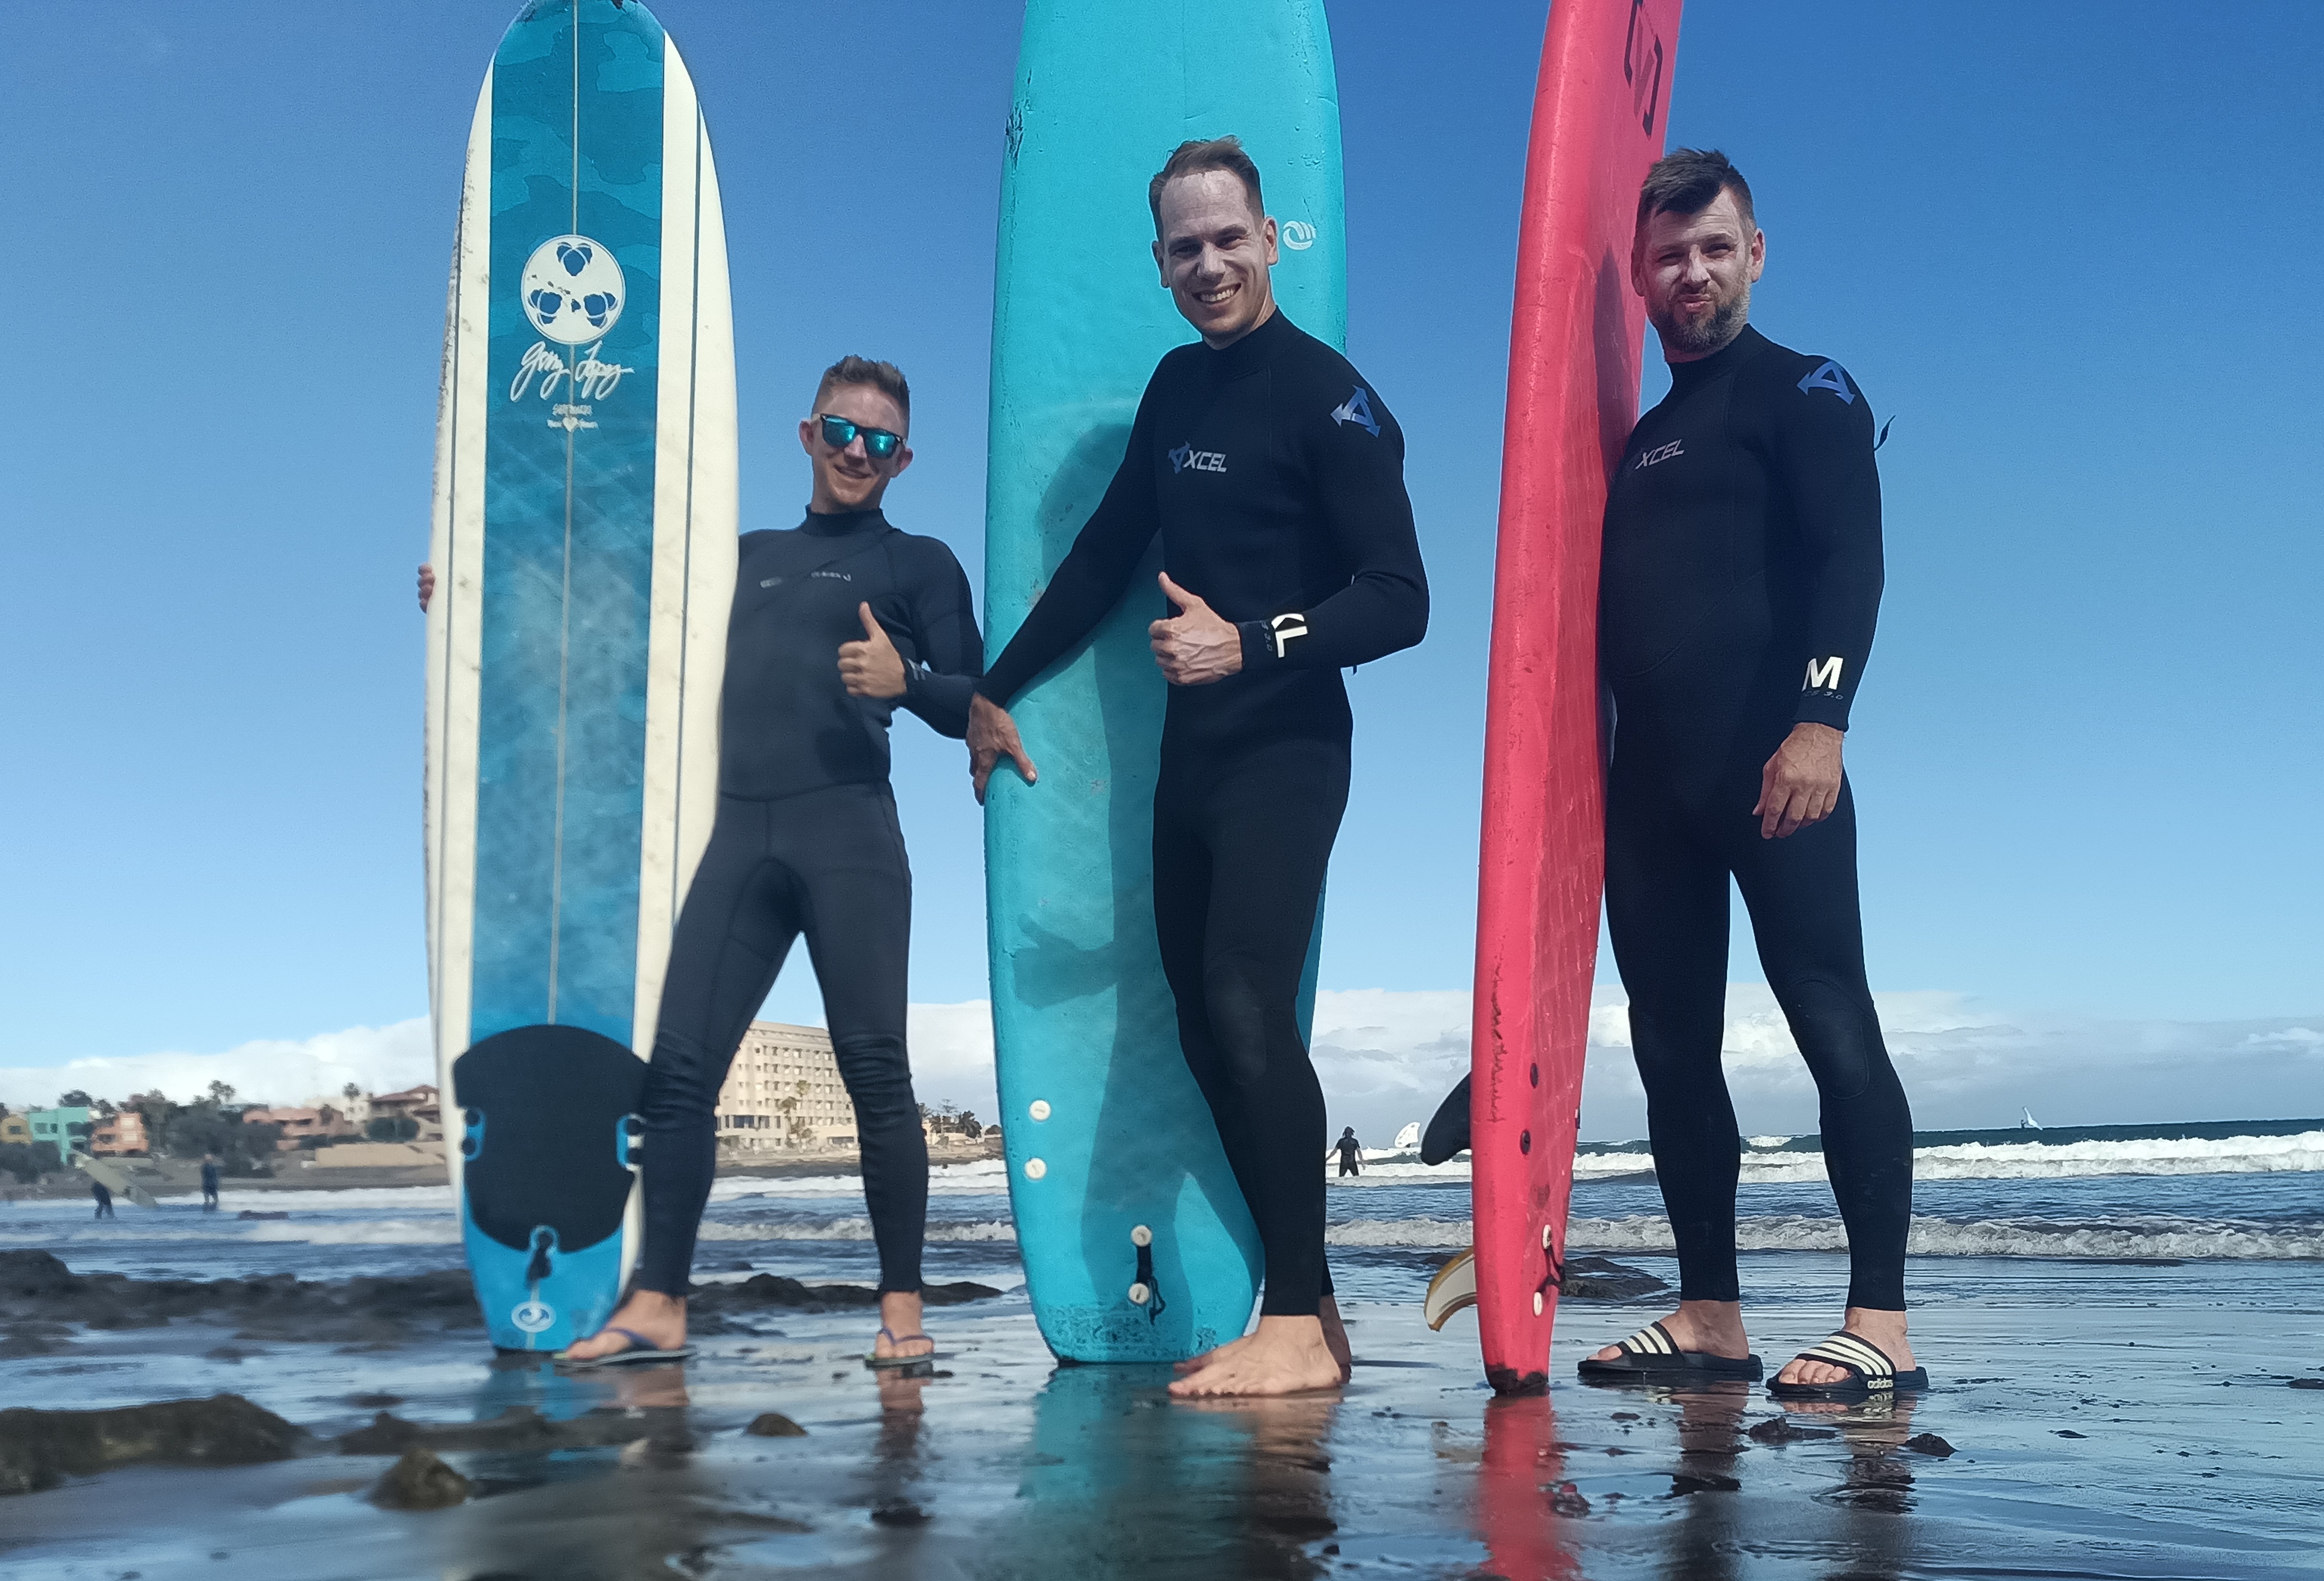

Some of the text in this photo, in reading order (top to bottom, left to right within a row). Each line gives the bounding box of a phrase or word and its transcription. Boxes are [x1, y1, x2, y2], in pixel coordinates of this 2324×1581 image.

[1183, 450, 1227, 472] XCEL
[1635, 439, 1684, 469] XCEL
[1802, 656, 1843, 692] M
[1867, 1378, 1893, 1389] adidas
